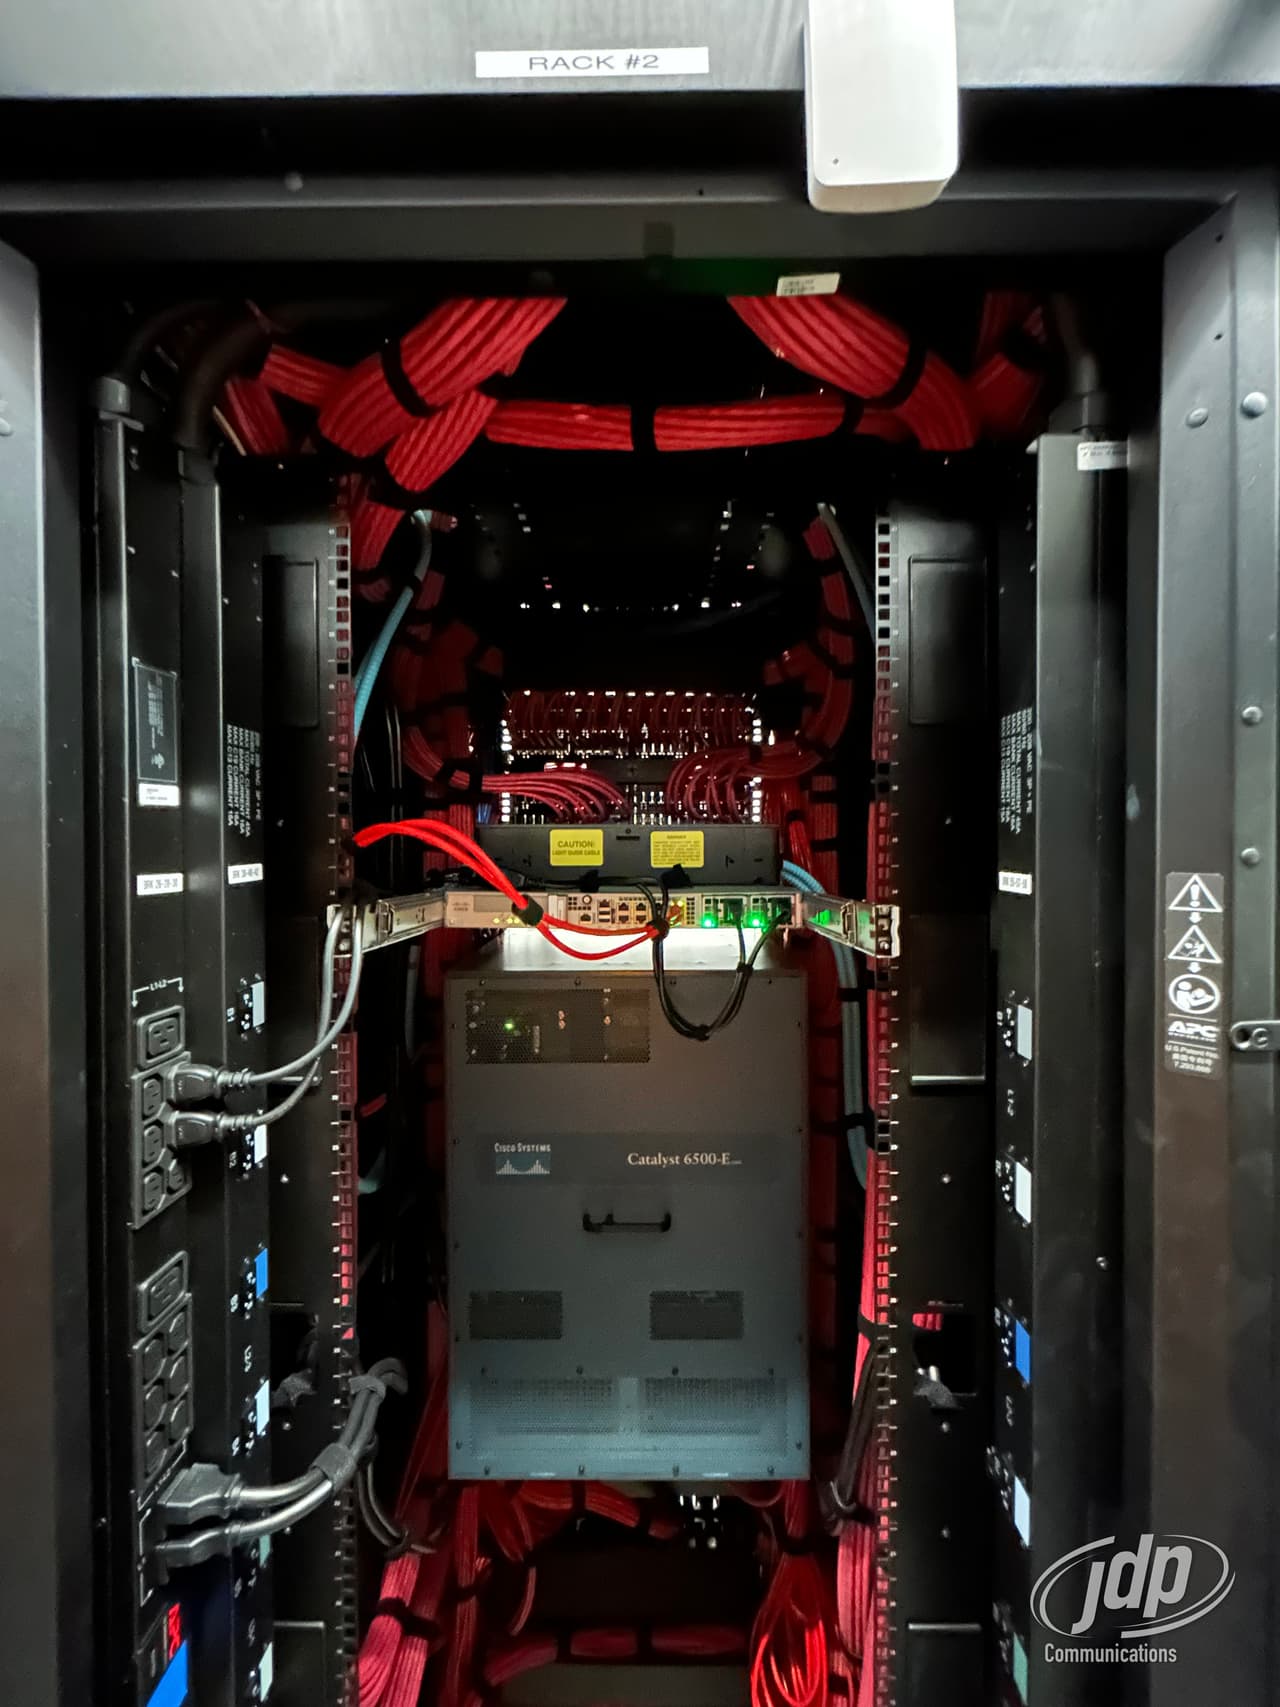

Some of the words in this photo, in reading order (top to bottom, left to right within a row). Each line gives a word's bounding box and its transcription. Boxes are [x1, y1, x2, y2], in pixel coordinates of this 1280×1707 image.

[529, 56, 614, 70] RACK
[625, 54, 660, 70] #2
[1168, 1020, 1219, 1038] APC
[494, 1142, 516, 1152] CISCO
[517, 1142, 551, 1152] SYSTEMS
[627, 1153, 680, 1168] Catalyst
[683, 1153, 730, 1166] 6500-E
